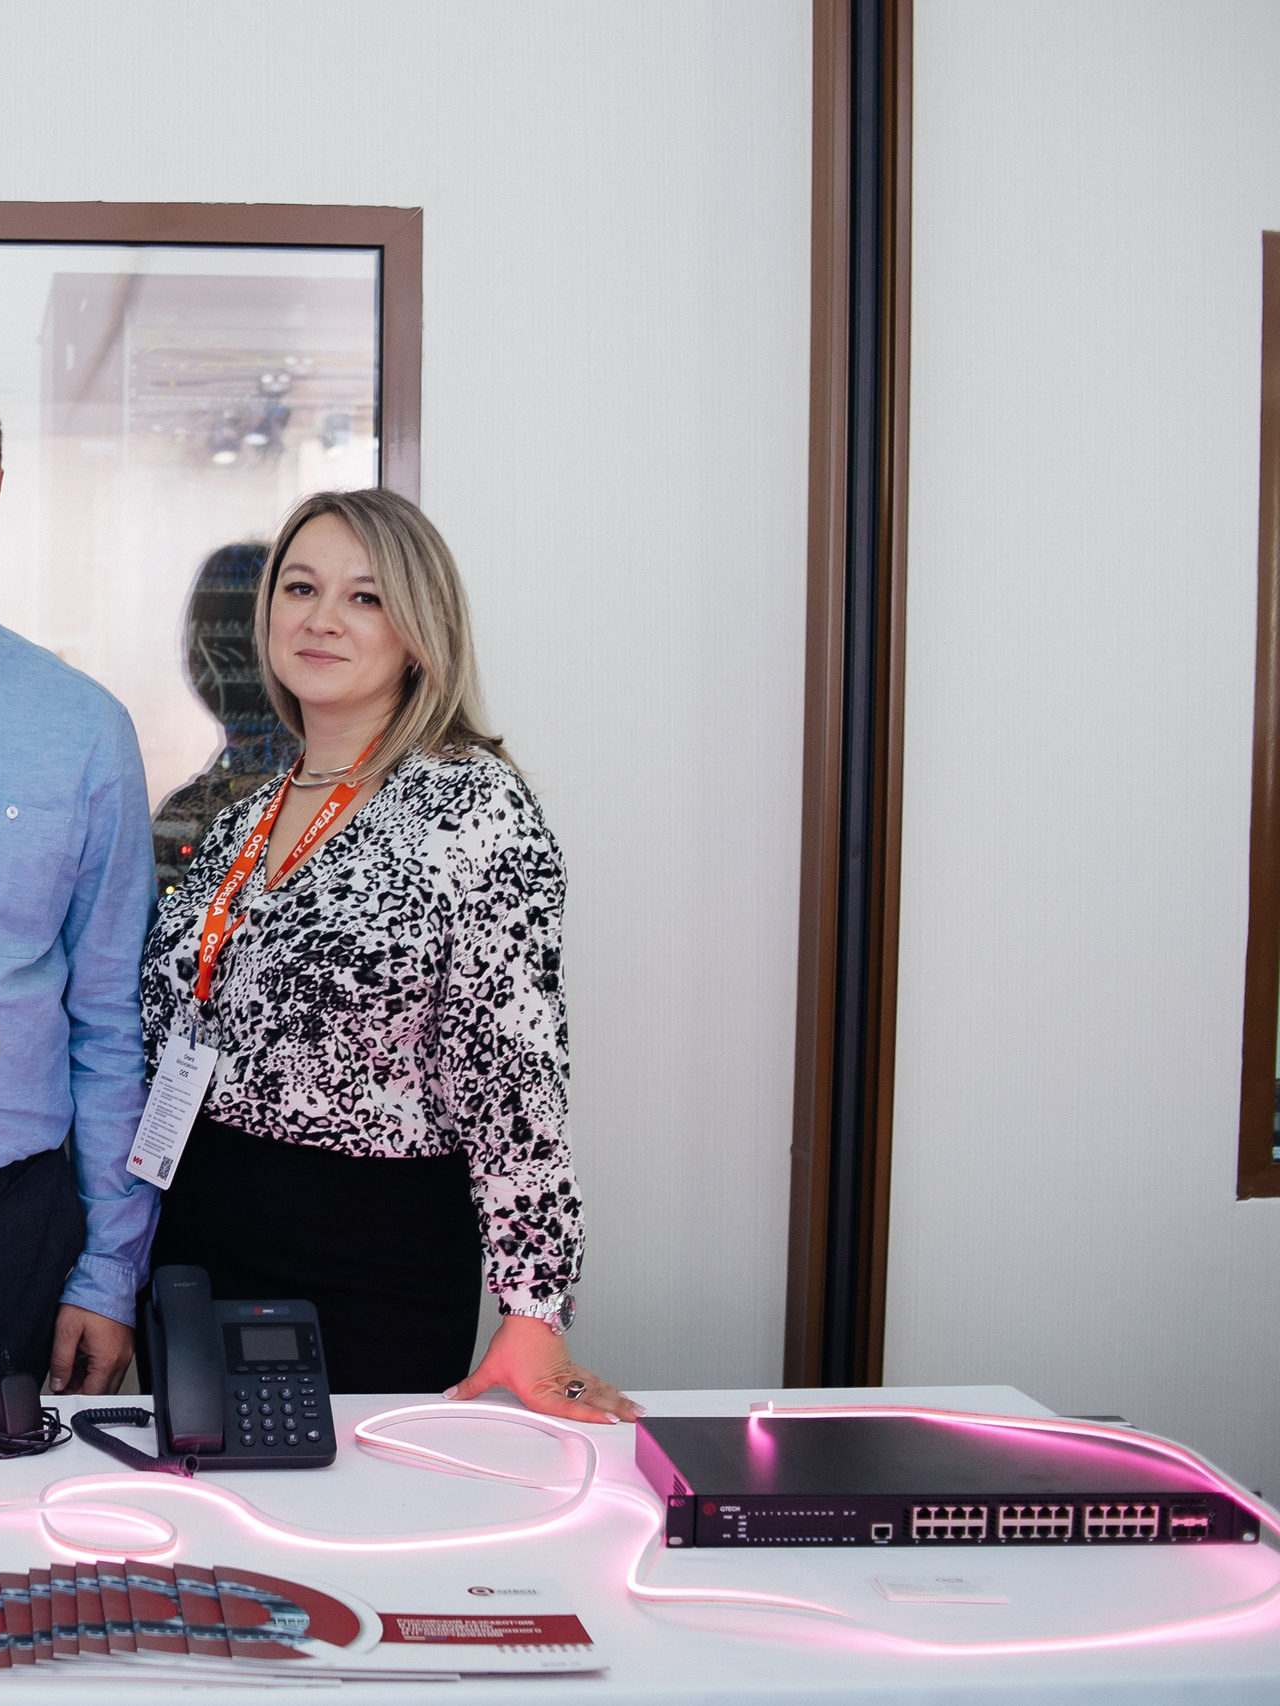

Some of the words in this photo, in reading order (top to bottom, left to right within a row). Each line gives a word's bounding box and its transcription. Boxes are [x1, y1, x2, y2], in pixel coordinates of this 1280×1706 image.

[245, 833, 263, 859] OCS
[292, 800, 341, 859] IT-СРЕДА
[212, 870, 246, 916] IT-СРЕДА
[202, 932, 218, 963] OCS
